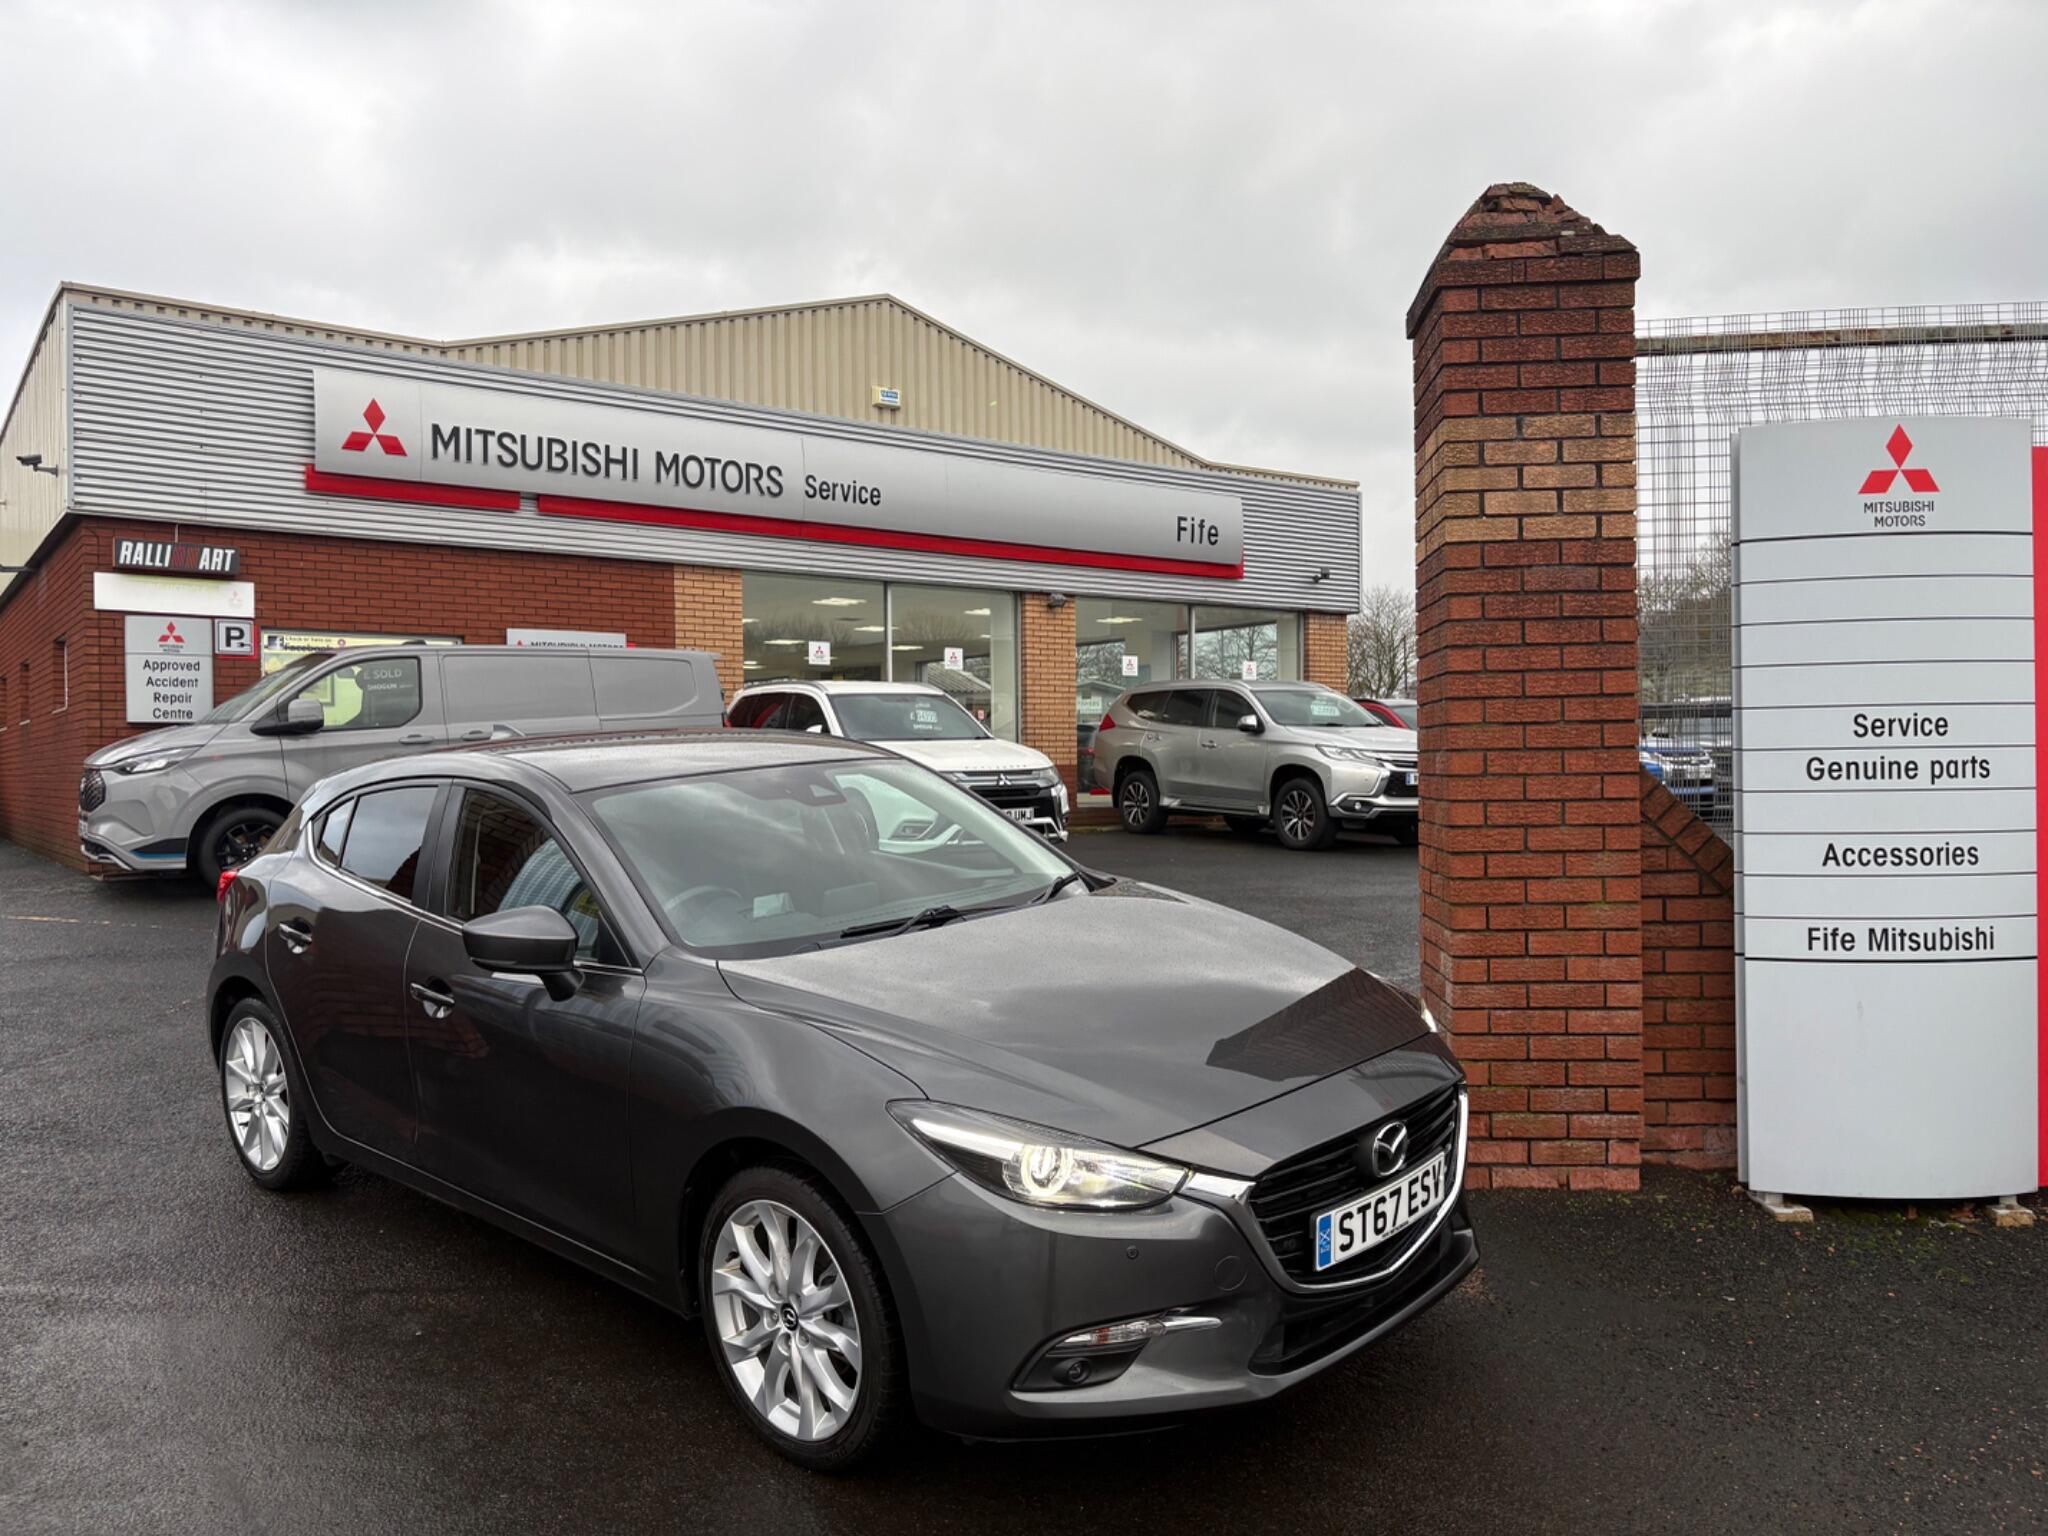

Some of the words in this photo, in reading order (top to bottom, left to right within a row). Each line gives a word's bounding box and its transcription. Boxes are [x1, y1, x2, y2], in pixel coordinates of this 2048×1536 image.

[431, 423, 639, 481] MITSUBISHI
[655, 450, 784, 499] MOTORS
[804, 475, 882, 507] Service
[1863, 500, 1935, 513] MITSUBISHI
[1177, 515, 1219, 546] Fife
[1874, 515, 1926, 528] MOTORS
[225, 626, 245, 648] P
[143, 659, 201, 673] Approved
[373, 668, 403, 680] SOLD
[146, 676, 199, 688] Accident
[153, 692, 193, 705] Repair
[152, 707, 193, 719] Centre
[1853, 712, 1949, 738] Service
[1806, 755, 1919, 781] Genuine
[1930, 755, 1991, 786] parts
[1822, 841, 1979, 867] Accessories
[1807, 927, 1856, 952] Fife
[1868, 925, 1995, 952] Mitsubishi
[1338, 1186, 1402, 1253] ST67
